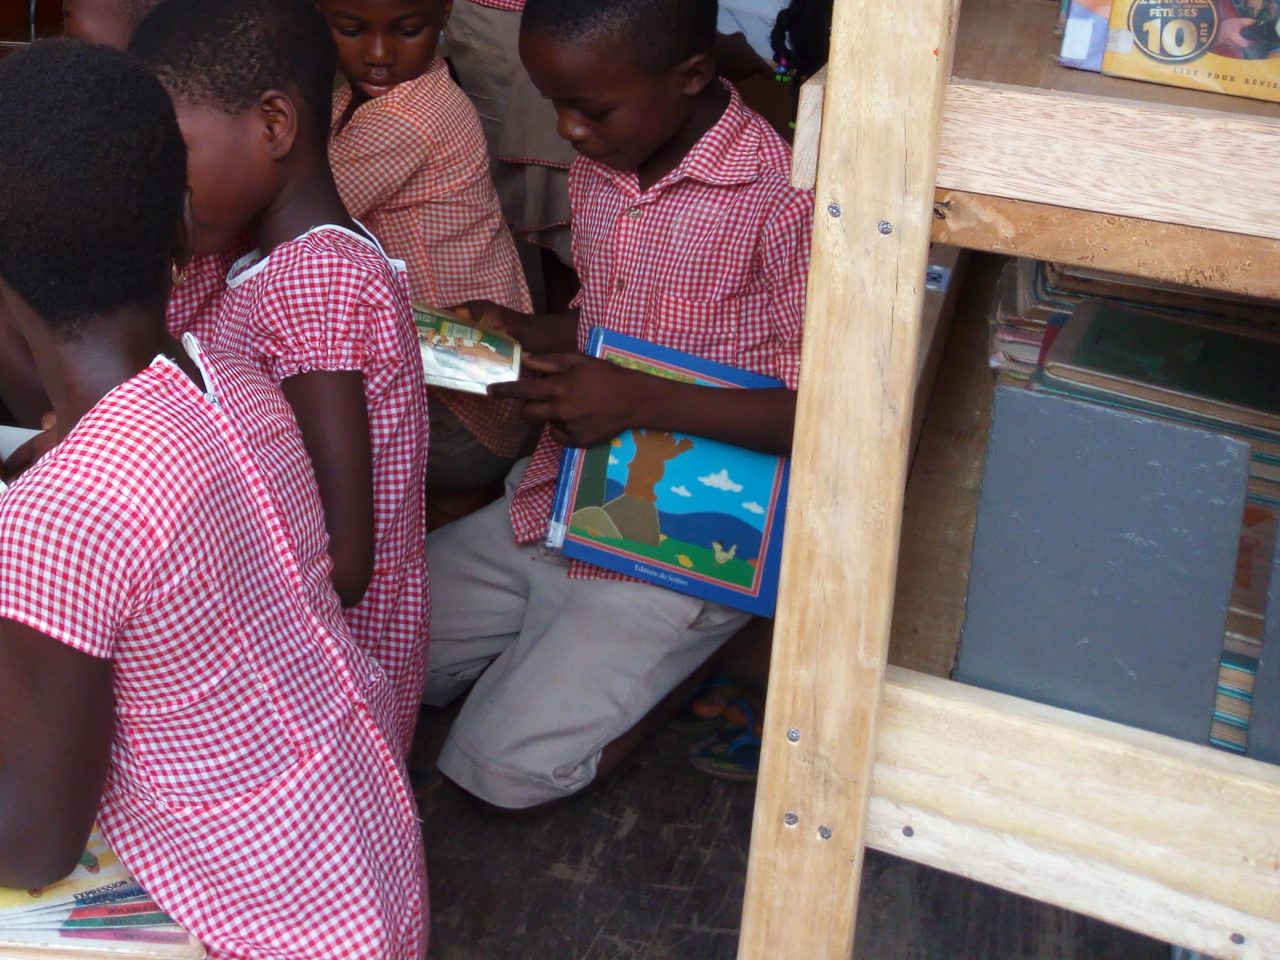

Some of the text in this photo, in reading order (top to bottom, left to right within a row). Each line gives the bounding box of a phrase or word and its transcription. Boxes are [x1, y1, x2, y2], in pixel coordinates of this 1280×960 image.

[1149, 6, 1197, 17] FÊTE SES
[1142, 18, 1198, 56] 10
[1200, 22, 1208, 44] ans
[73, 877, 129, 902] EXPRESSION
